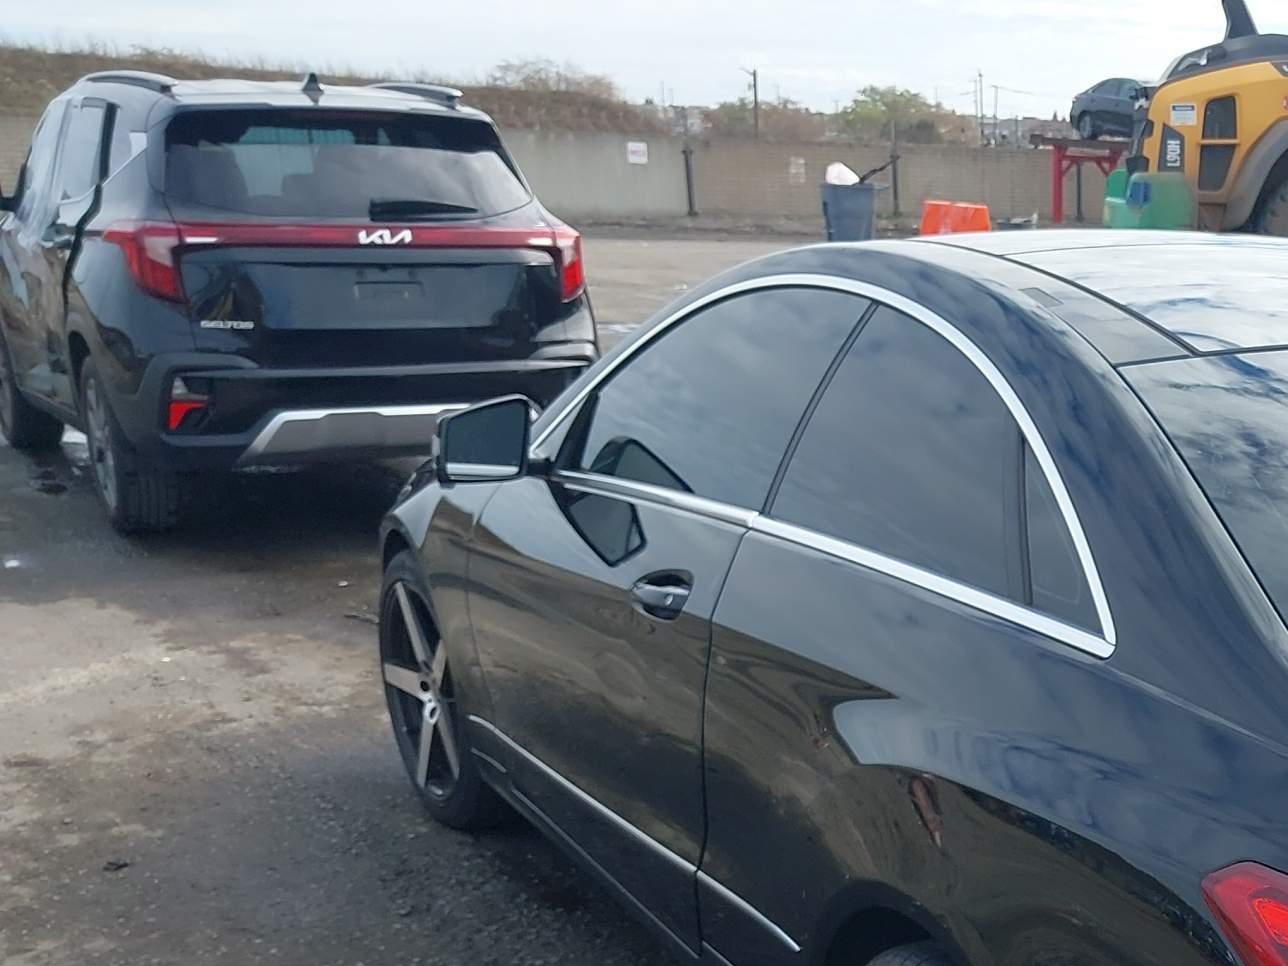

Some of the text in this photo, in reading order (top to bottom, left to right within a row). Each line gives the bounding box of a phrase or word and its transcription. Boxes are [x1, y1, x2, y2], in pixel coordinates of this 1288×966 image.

[1166, 140, 1181, 168] L90H
[358, 228, 413, 245] KIA
[200, 320, 255, 330] SELTOS
